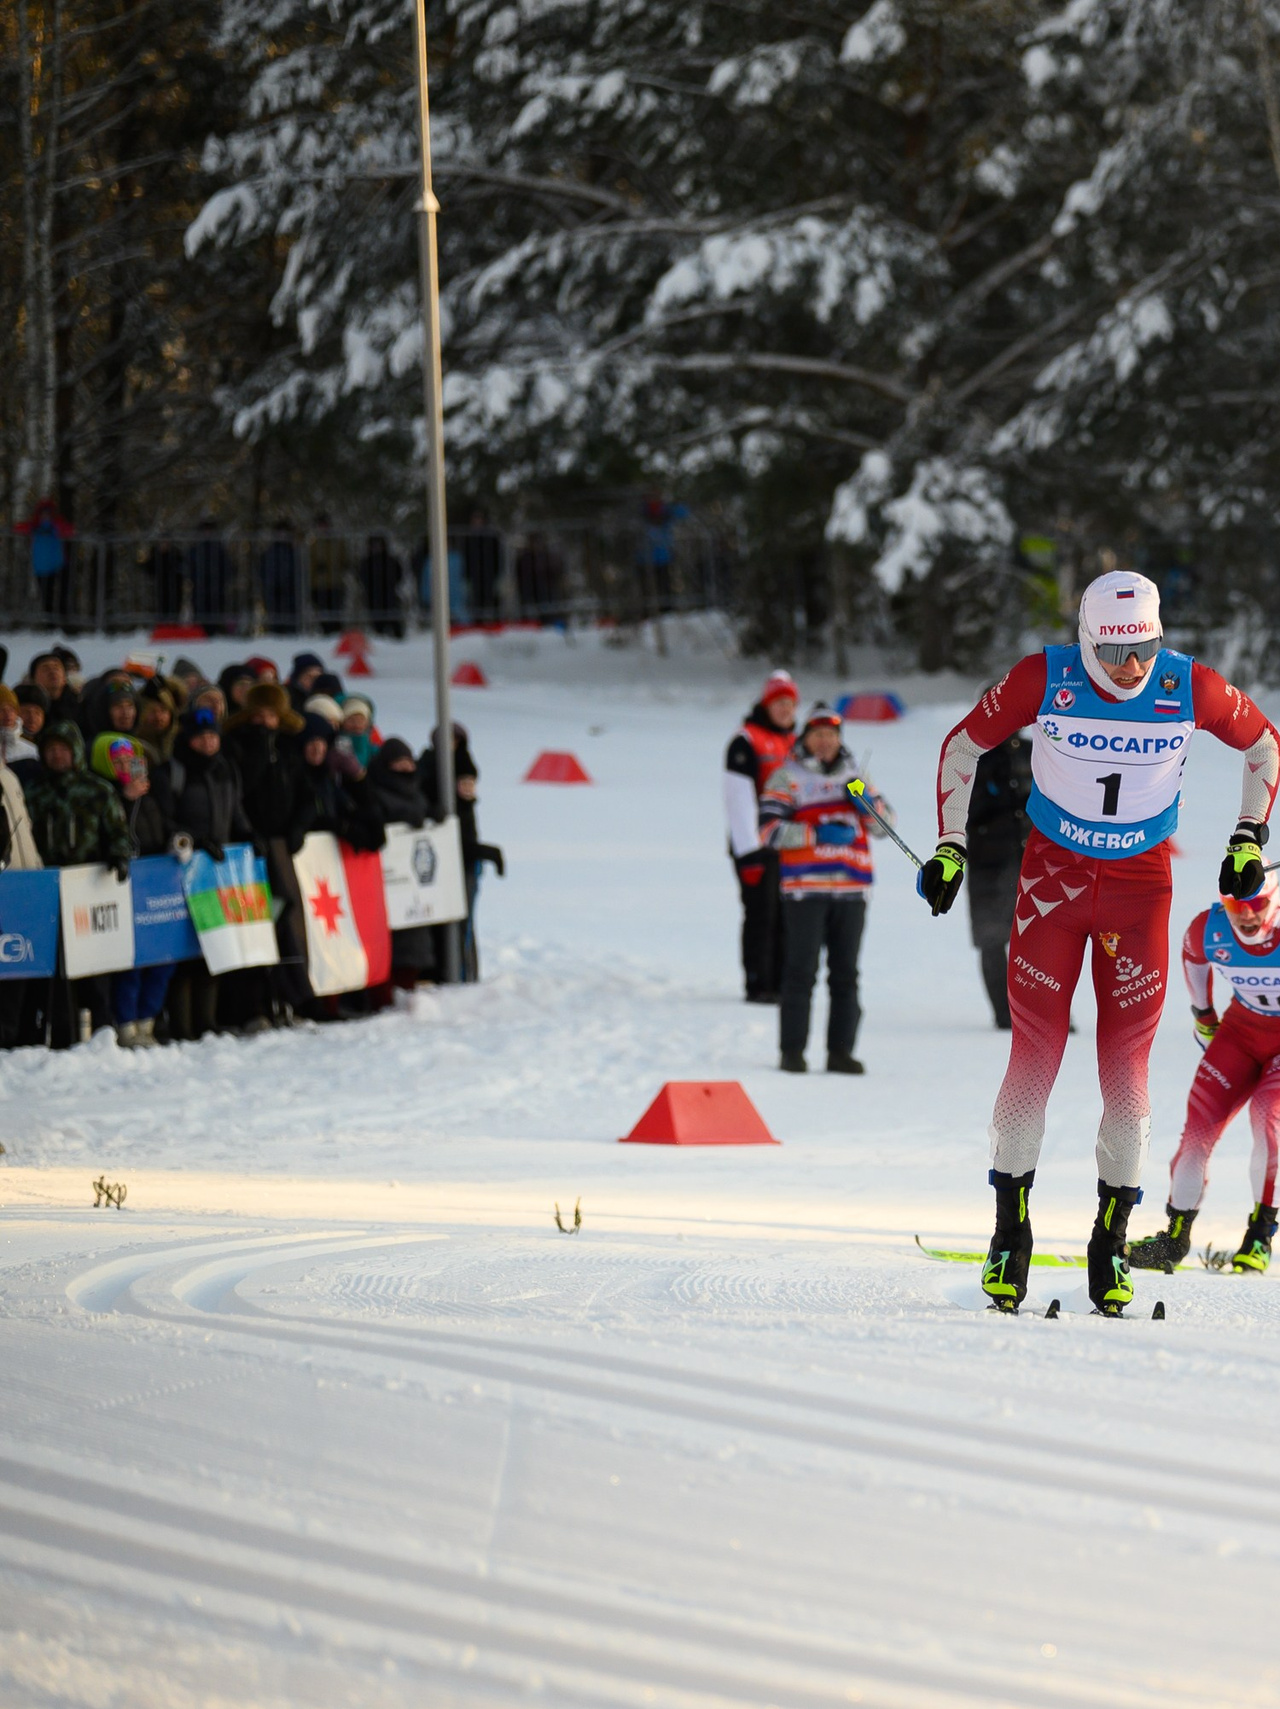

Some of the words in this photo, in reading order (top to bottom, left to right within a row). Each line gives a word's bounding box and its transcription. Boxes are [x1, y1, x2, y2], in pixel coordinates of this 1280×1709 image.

[1099, 621, 1154, 635] ЛУКОЙЛ
[1068, 732, 1184, 754] ФОСАГРО
[1096, 773, 1122, 816] 1
[1014, 955, 1061, 992] ЛУКОЙЛ
[1112, 969, 1160, 997] ФОСАГРО
[1119, 981, 1163, 1009] BIVIUM
[1201, 1060, 1232, 1089] УКОЙЛ
